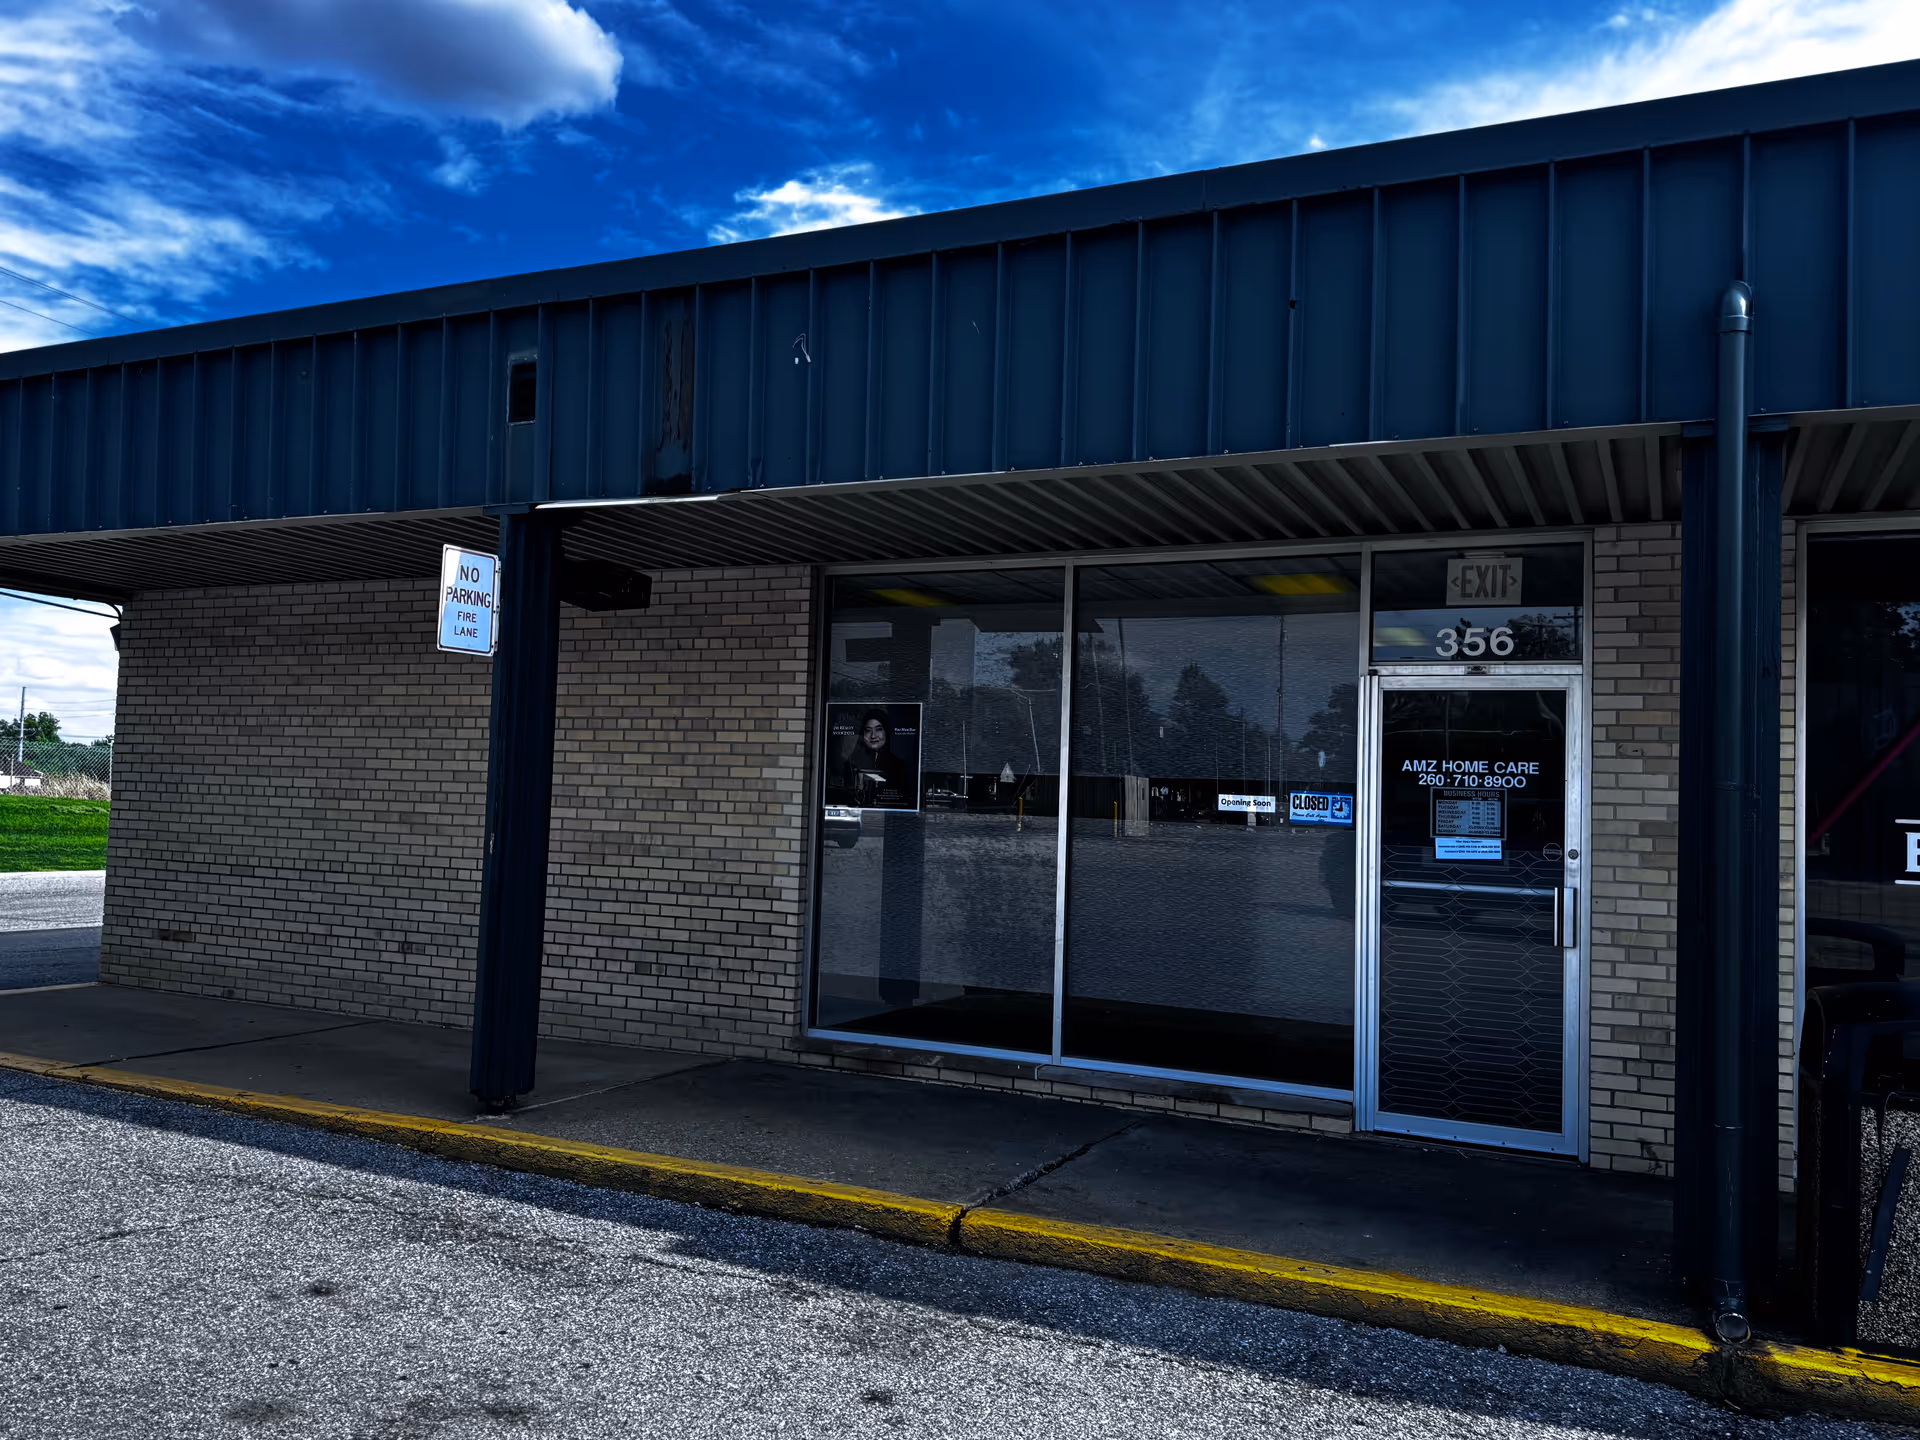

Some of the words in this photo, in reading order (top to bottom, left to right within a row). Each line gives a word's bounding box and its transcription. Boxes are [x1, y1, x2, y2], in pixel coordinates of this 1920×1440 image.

[460, 564, 480, 583] NO
[1460, 564, 1512, 599] EXIT
[445, 586, 491, 609] PARKING
[457, 611, 477, 623] FIRE
[454, 625, 478, 638] LANE
[1435, 626, 1514, 657] 356
[1401, 760, 1437, 772] AMZ
[1442, 760, 1489, 773] HOME
[1493, 762, 1540, 775] CARE
[1443, 789, 1476, 797] BUSINESS
[1477, 790, 1500, 798] HOURS
[1220, 798, 1251, 807] Opening
[1252, 799, 1271, 807] Soon
[1292, 794, 1329, 811] CLOSED
